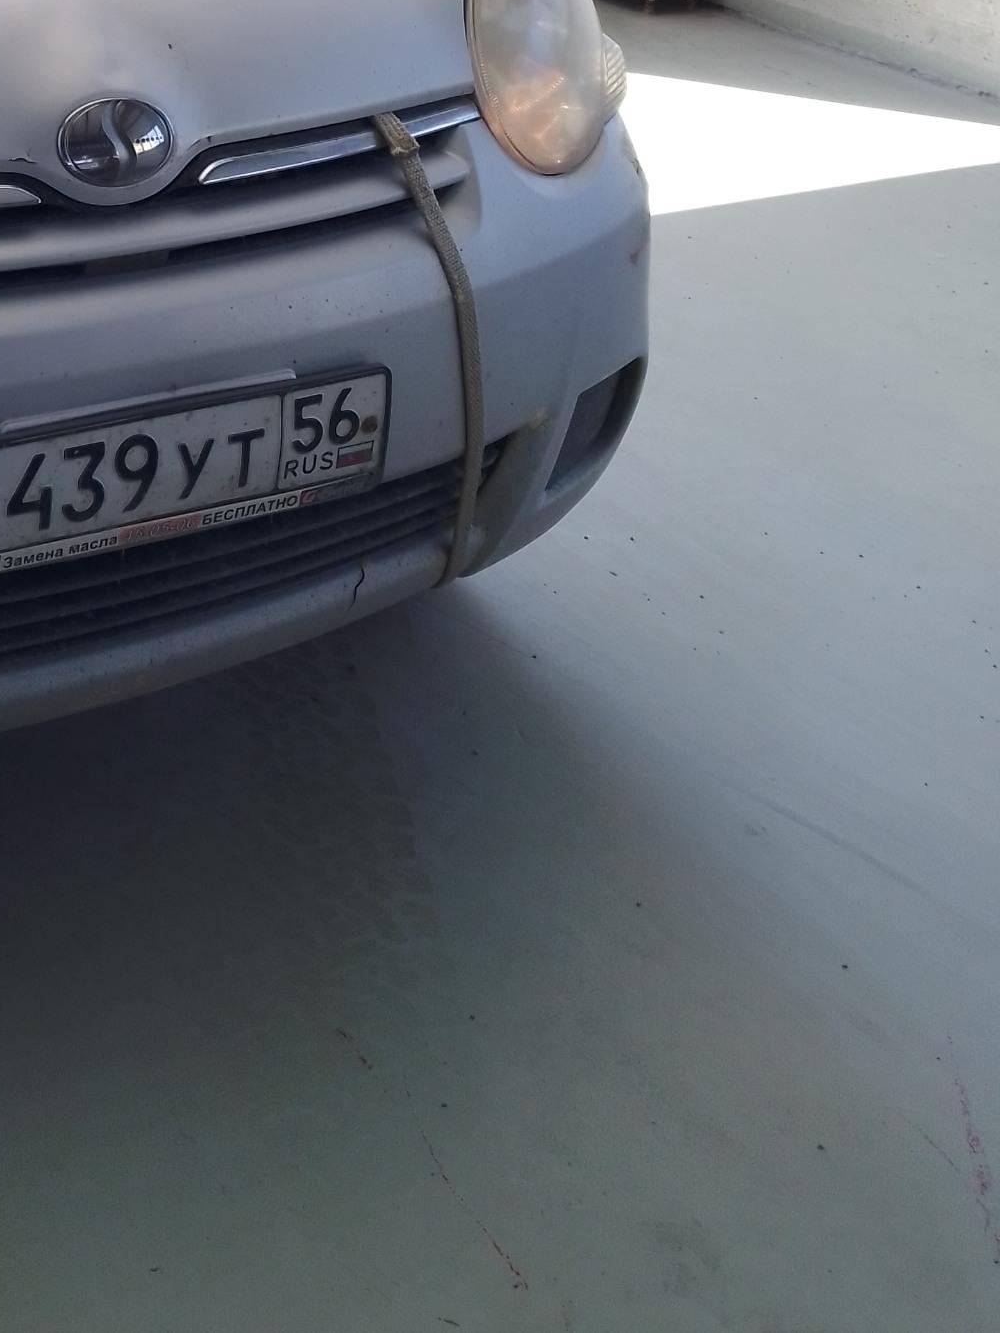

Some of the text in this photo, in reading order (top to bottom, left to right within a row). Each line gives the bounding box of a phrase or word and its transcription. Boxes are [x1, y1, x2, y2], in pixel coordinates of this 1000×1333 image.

[293, 387, 361, 454] 56
[283, 451, 335, 480] RUS
[3, 548, 63, 569] Замена
[68, 534, 118, 555] масла
[202, 494, 299, 525] БЕСПЛАТНО
